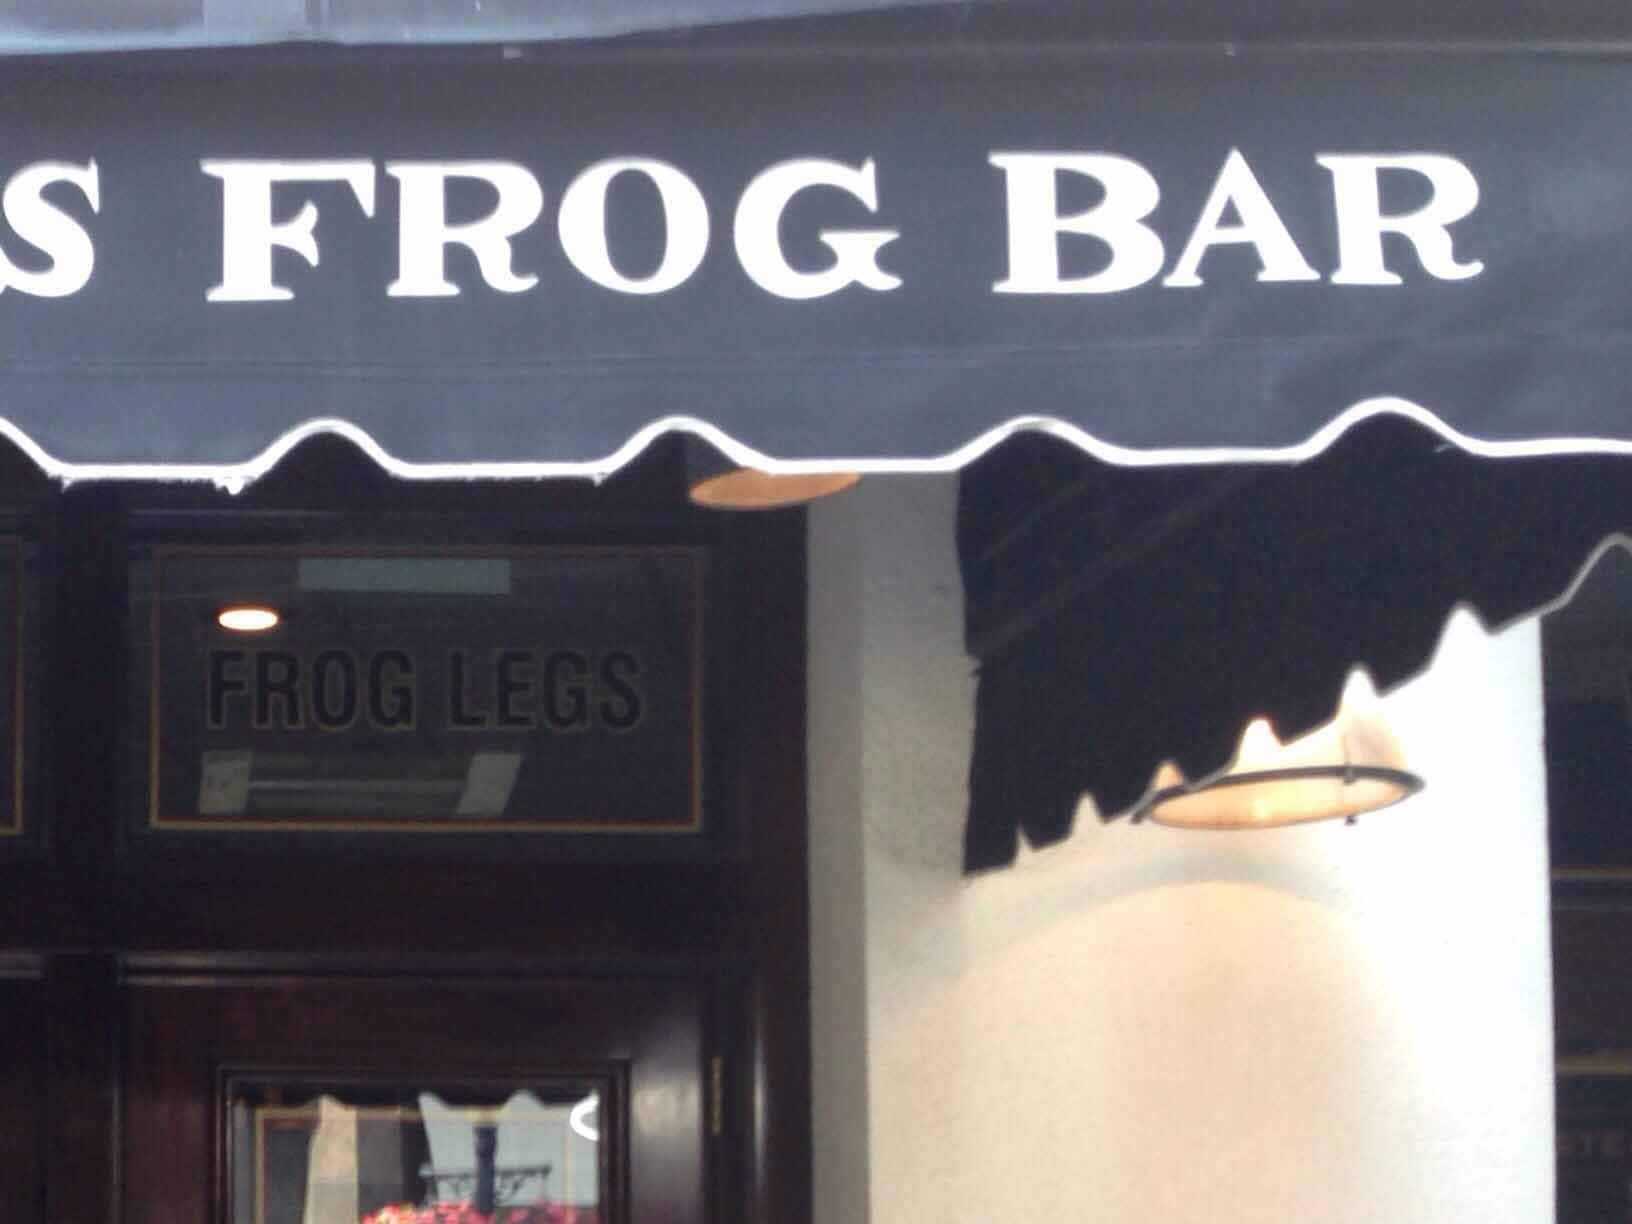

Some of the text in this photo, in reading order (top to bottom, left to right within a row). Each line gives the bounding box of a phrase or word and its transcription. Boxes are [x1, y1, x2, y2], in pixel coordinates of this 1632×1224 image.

[200, 156, 903, 302] FROG
[987, 147, 1485, 295] BAR
[205, 648, 644, 731] FROG LEGS
